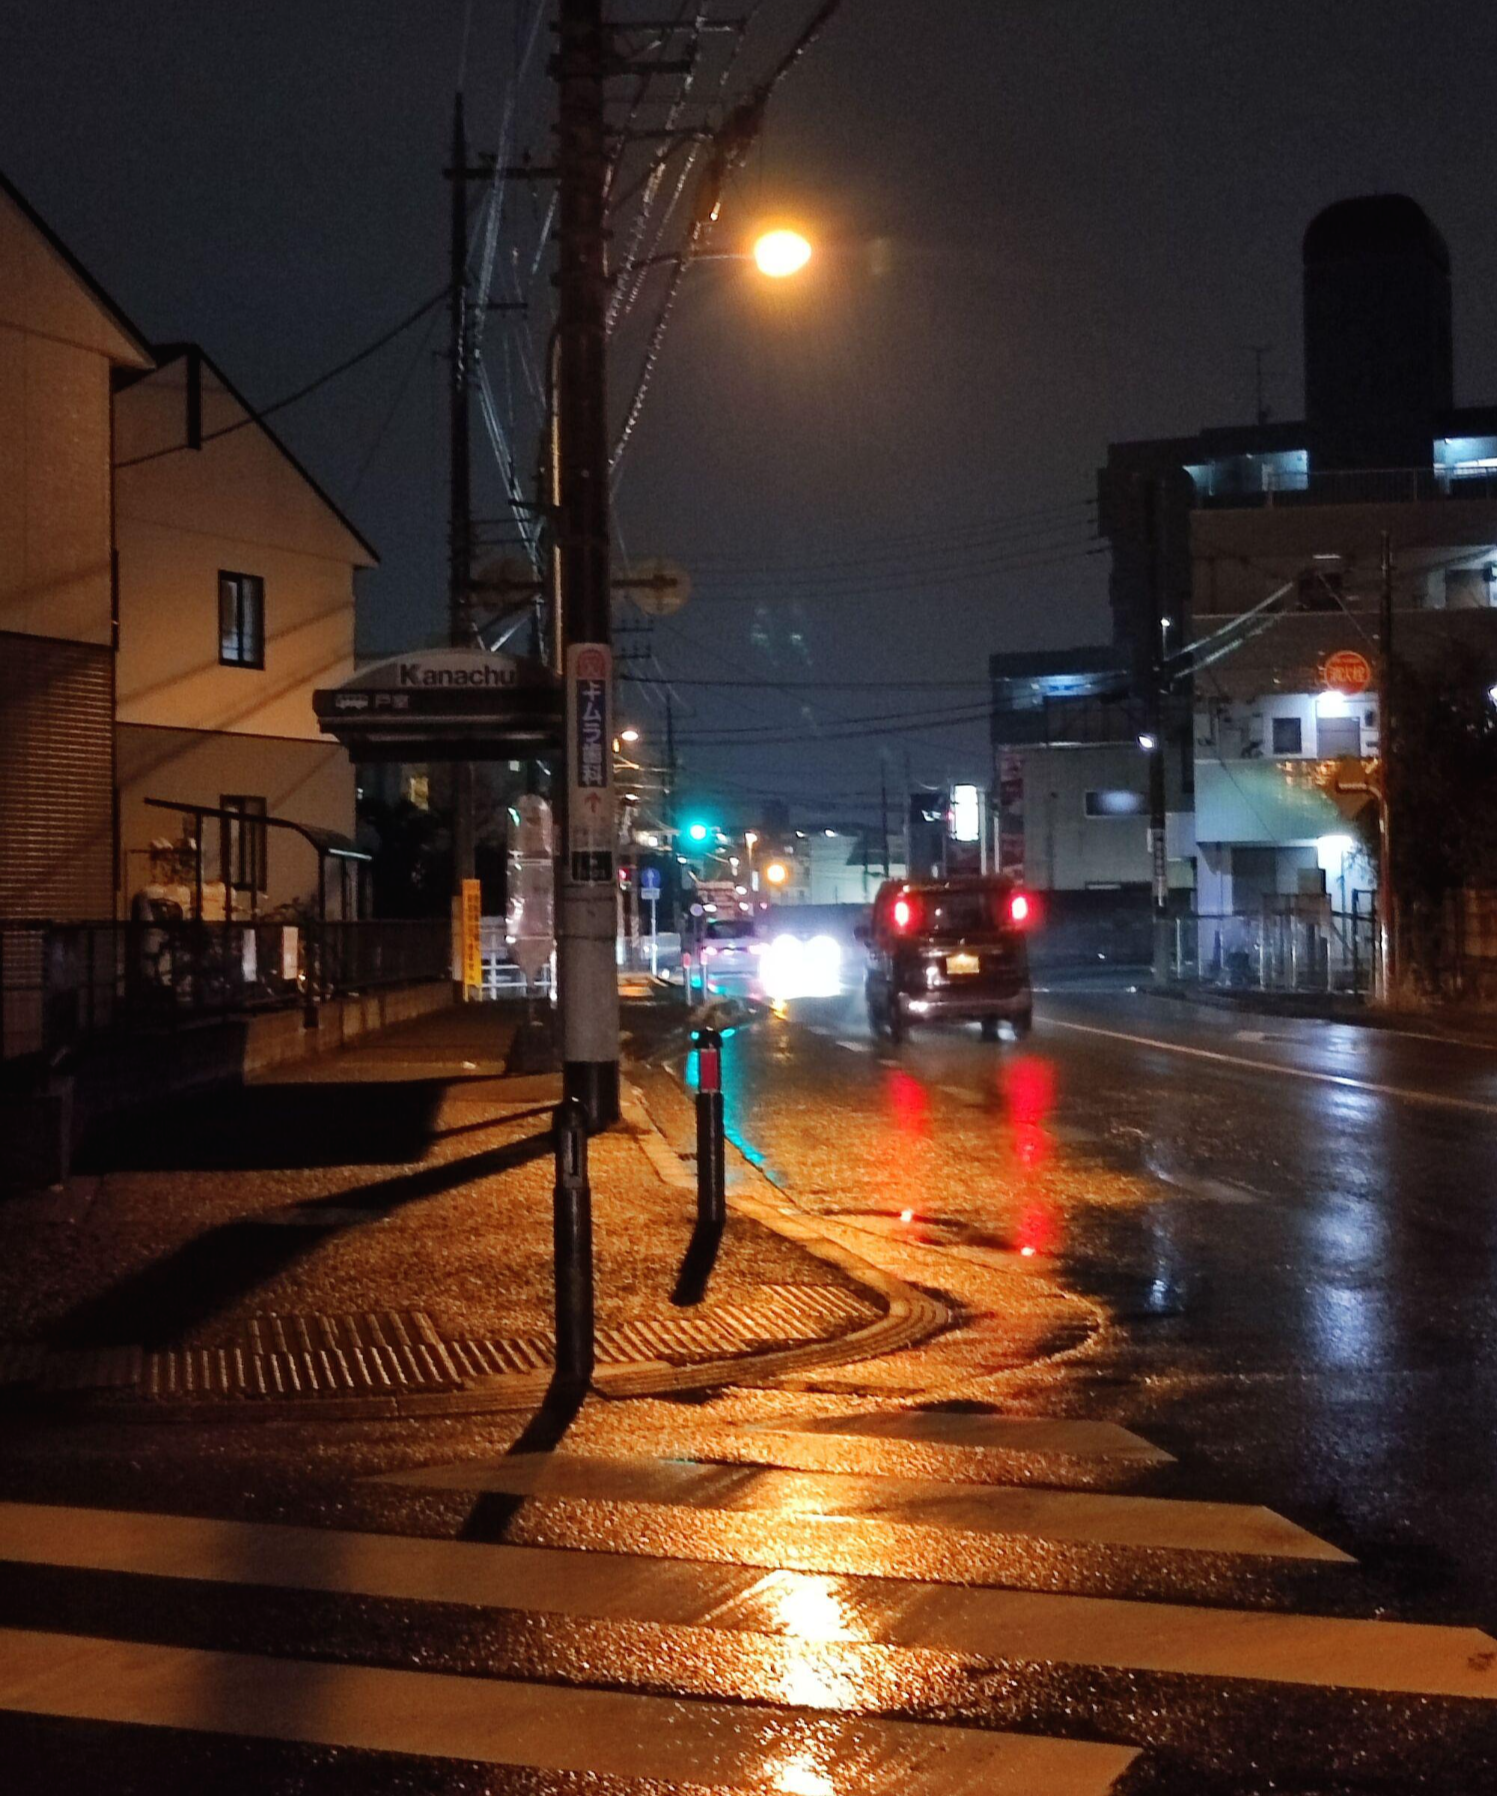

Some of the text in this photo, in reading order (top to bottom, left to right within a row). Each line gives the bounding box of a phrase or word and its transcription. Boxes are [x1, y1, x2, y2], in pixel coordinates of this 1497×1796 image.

[400, 664, 516, 687] Kanachu
[581, 682, 603, 787] キムラ歯科
